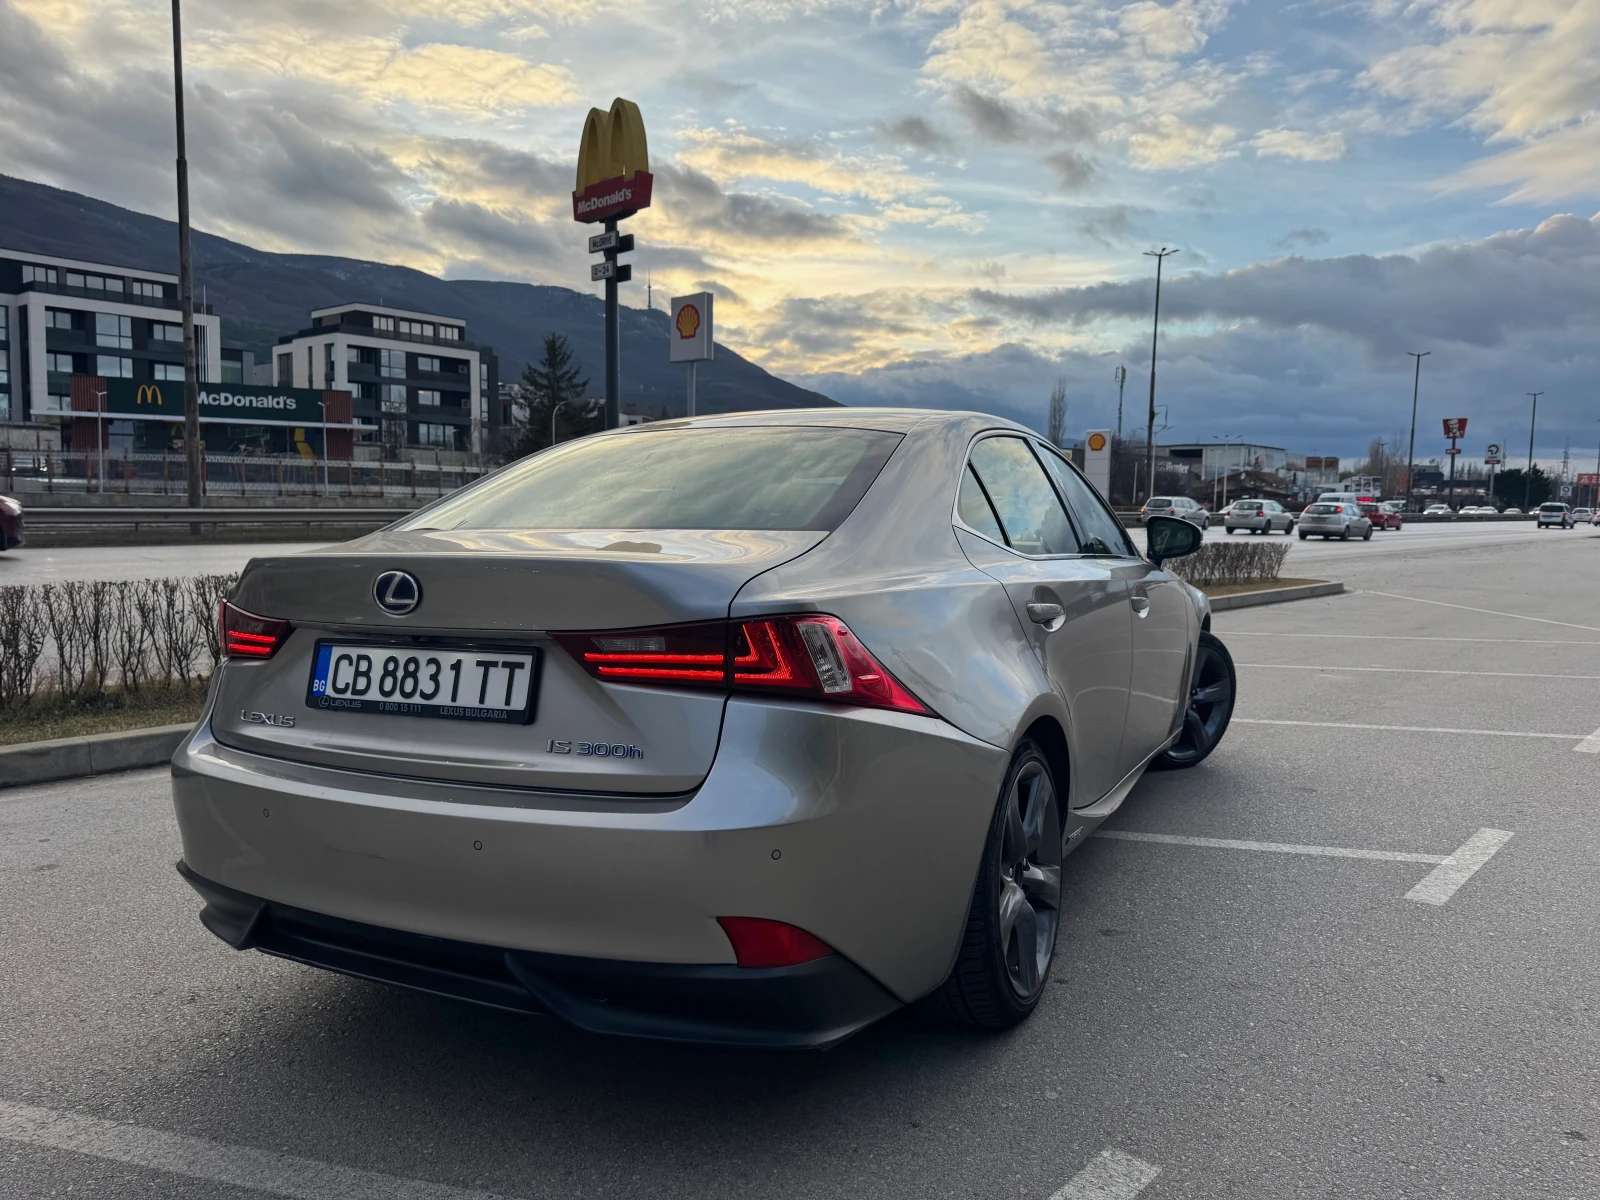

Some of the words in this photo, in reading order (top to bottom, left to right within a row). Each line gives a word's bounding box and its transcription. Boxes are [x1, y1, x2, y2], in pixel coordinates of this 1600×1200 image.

[577, 188, 632, 214] McDonald's
[592, 235, 613, 248] McDRIVE
[197, 391, 297, 410] McDonald's
[313, 679, 326, 692] BG
[331, 653, 373, 696] CB
[379, 655, 462, 703] 8831
[475, 660, 525, 707] TT
[330, 699, 362, 708] LEXUS
[379, 702, 384, 710] 0
[385, 702, 398, 711] 800
[400, 703, 408, 712] 15
[410, 704, 421, 713] 111
[240, 709, 296, 728] LEXUS
[440, 706, 464, 716] LEXUS
[465, 708, 508, 719] BULGARIA
[546, 739, 572, 754] IS
[576, 741, 644, 759] 300h
